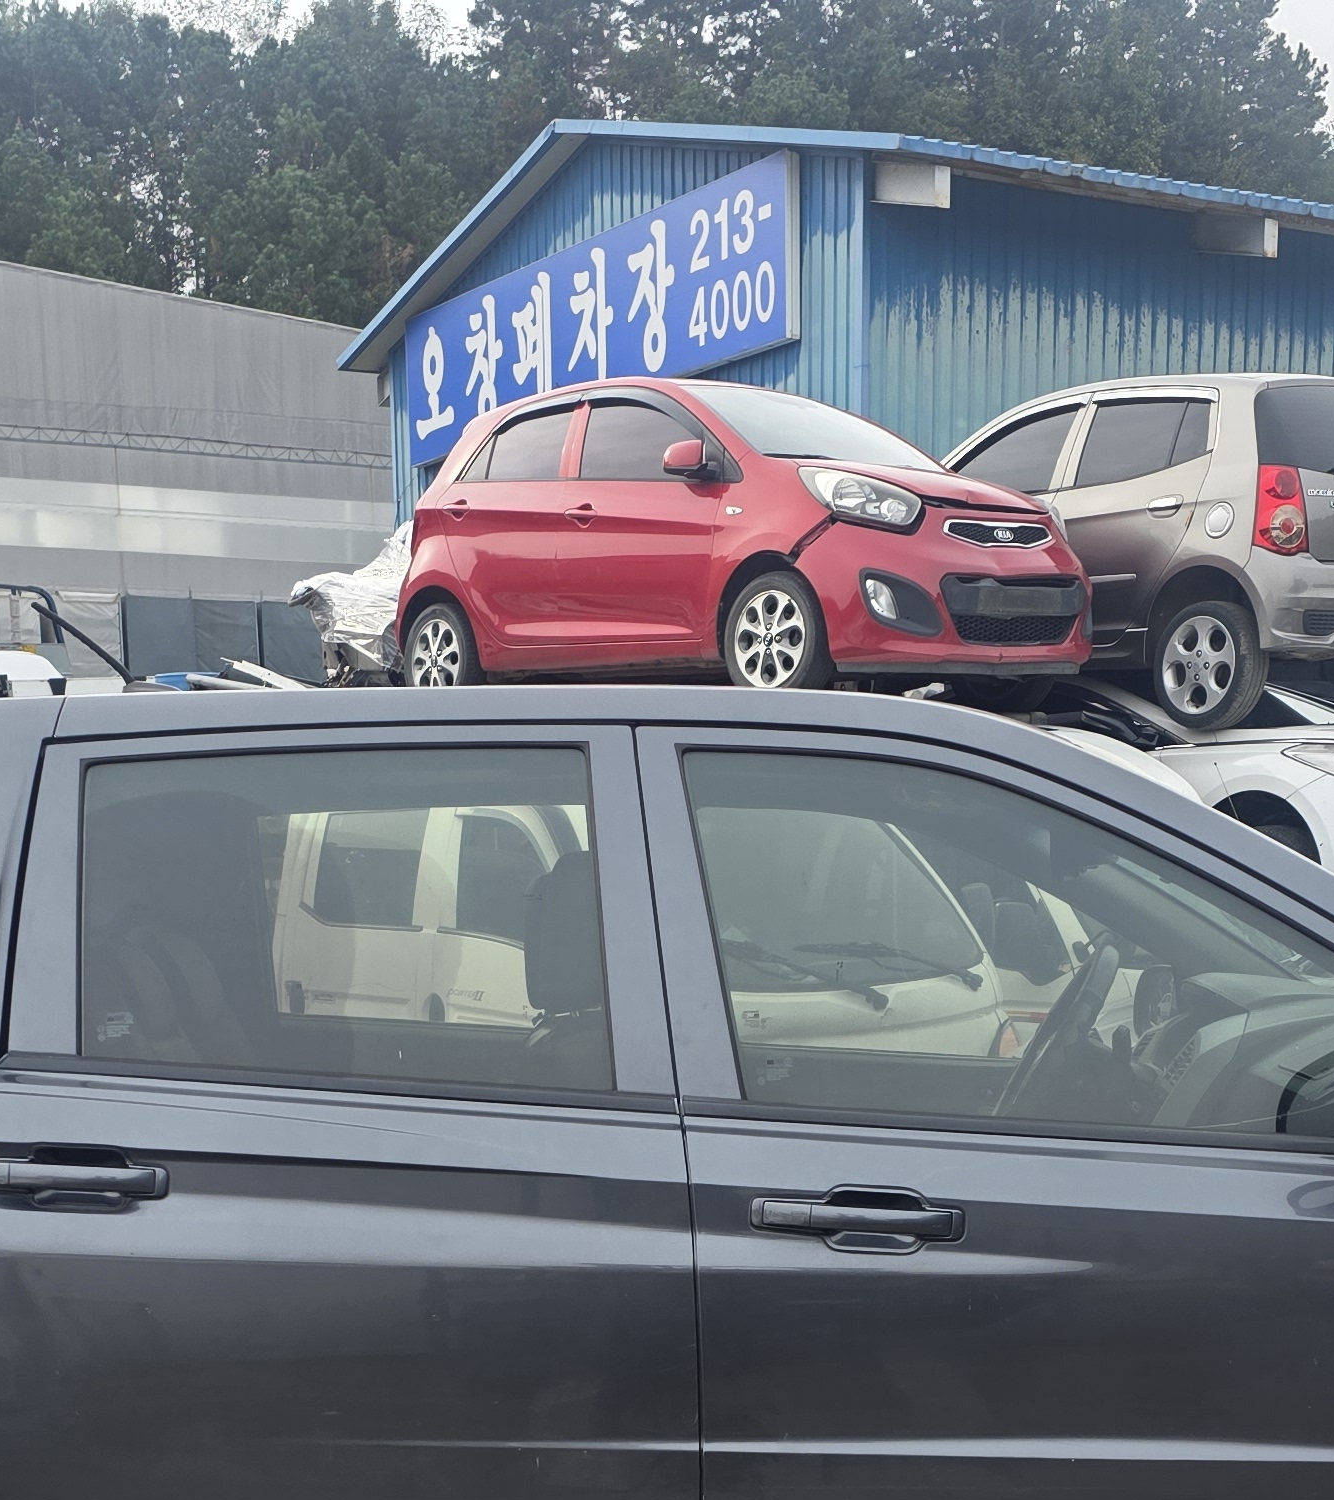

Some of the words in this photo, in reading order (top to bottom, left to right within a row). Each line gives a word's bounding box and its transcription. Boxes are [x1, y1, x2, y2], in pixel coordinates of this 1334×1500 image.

[689, 188, 773, 274] 213-
[415, 219, 675, 440] 오창폐차장
[688, 260, 776, 347] 4000
